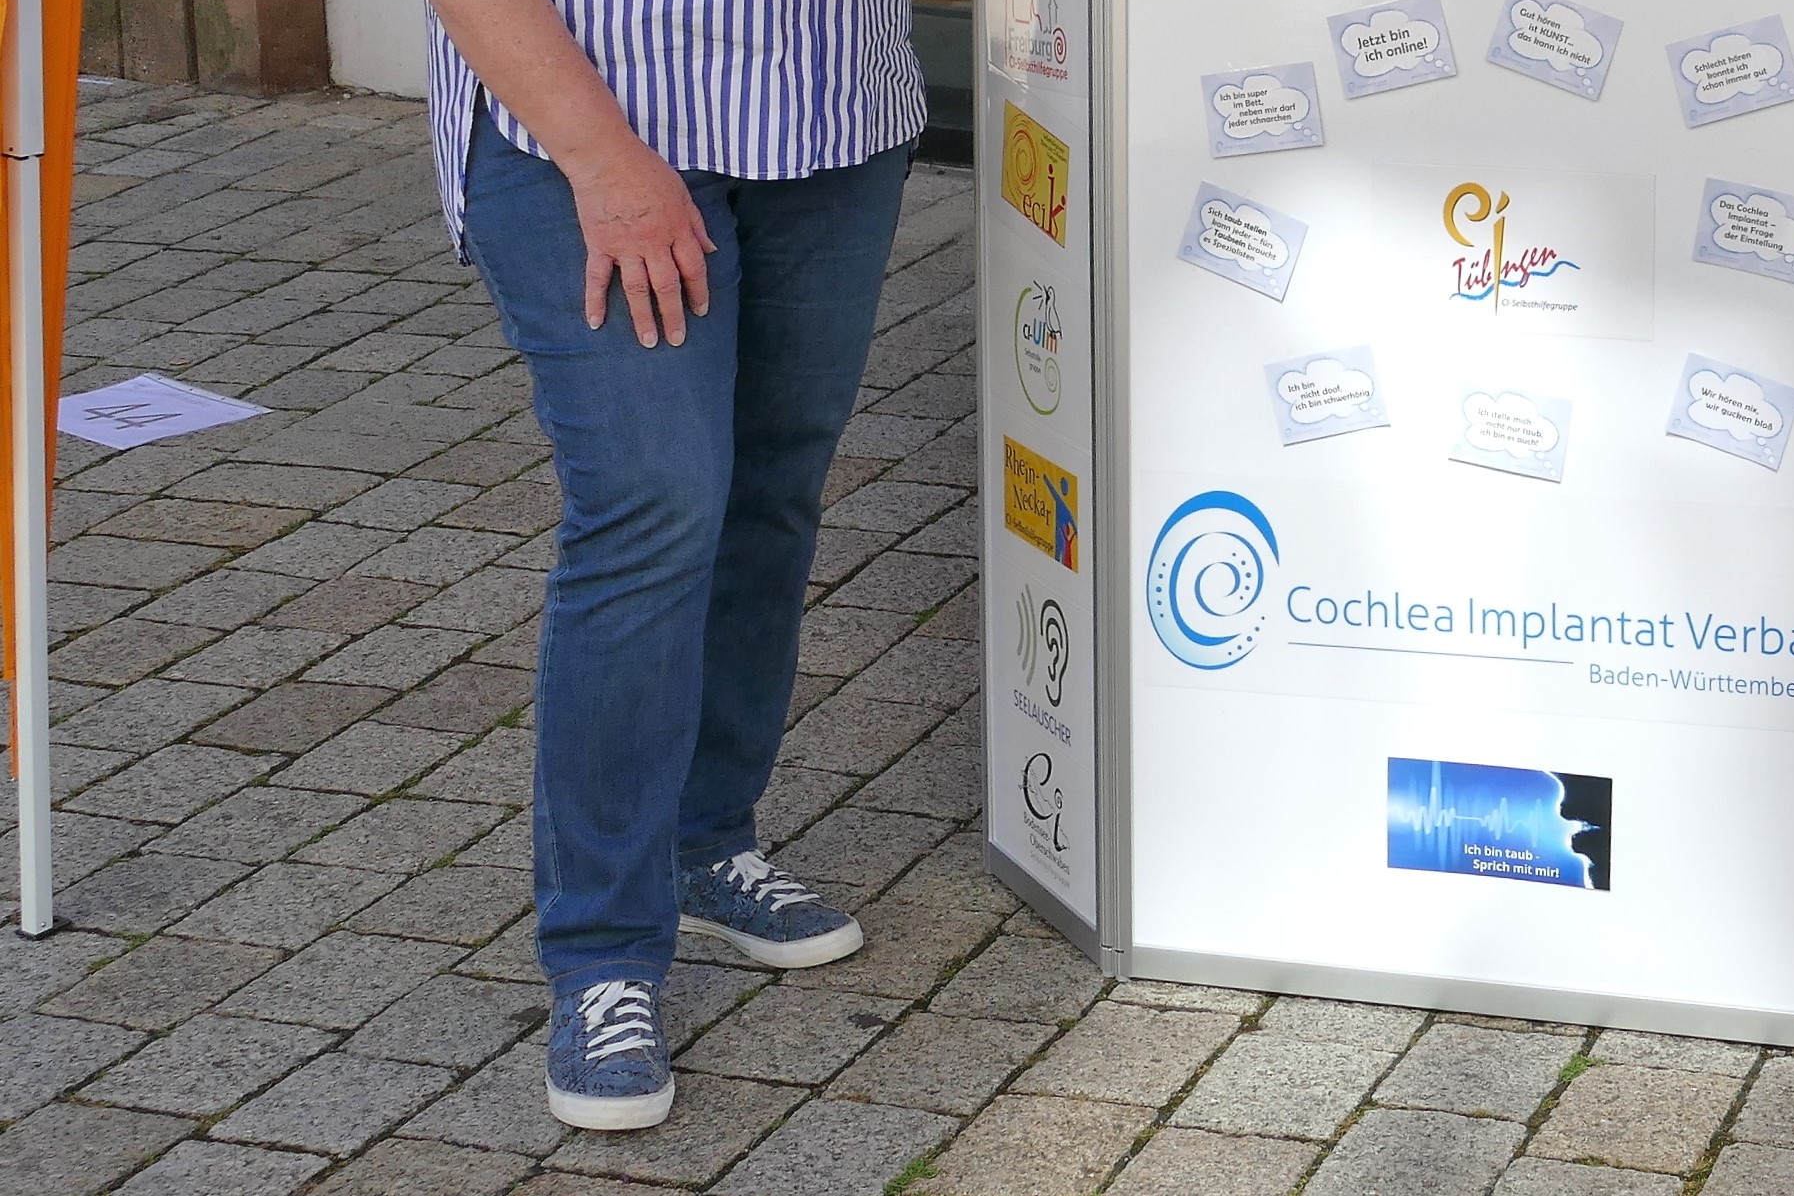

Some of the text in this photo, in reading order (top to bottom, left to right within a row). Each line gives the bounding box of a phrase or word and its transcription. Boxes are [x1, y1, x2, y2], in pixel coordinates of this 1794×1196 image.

[1520, 8, 1561, 29] Gut hören
[1528, 24, 1538, 32] ist
[1008, 27, 1053, 62] Freiburg
[1357, 29, 1410, 50] Jetzt bin
[1364, 37, 1428, 62] ich online!
[1517, 32, 1532, 43] das
[1556, 45, 1569, 57] ich
[1569, 51, 1591, 65] nicht
[1694, 52, 1752, 73] Schlecht hören
[1736, 62, 1749, 72] ich
[1702, 68, 1768, 92] schon immer gut
[1233, 92, 1246, 100] bin
[1247, 90, 1268, 100] super
[1239, 109, 1263, 117] neben
[1265, 106, 1277, 115] mir
[1250, 114, 1292, 125] schnarchen
[1719, 200, 1769, 218] Das Cochlea
[1207, 206, 1267, 237] Sich taub stellen
[1727, 212, 1768, 228] Implantat
[1724, 231, 1783, 251] der Einstellung
[1731, 223, 1774, 239] eine Frage
[1213, 239, 1255, 262] Spezialisten
[1288, 381, 1315, 393] Ich bin
[1300, 390, 1321, 401] nicht
[1701, 386, 1716, 398] Wir
[1718, 393, 1743, 408] hören
[1295, 389, 1370, 411] ich bin schwerhörig
[1706, 402, 1720, 412] wir
[1005, 443, 1040, 485] Rhein-
[1013, 484, 1051, 526] Neckar
[1287, 584, 1453, 633] Cochlea
[1467, 597, 1674, 649] Implantat
[1014, 689, 1072, 747] SEELAUSCHER
[1464, 844, 1533, 861] Ich bin taub
[1473, 858, 1560, 879] Sprich mit mir!
